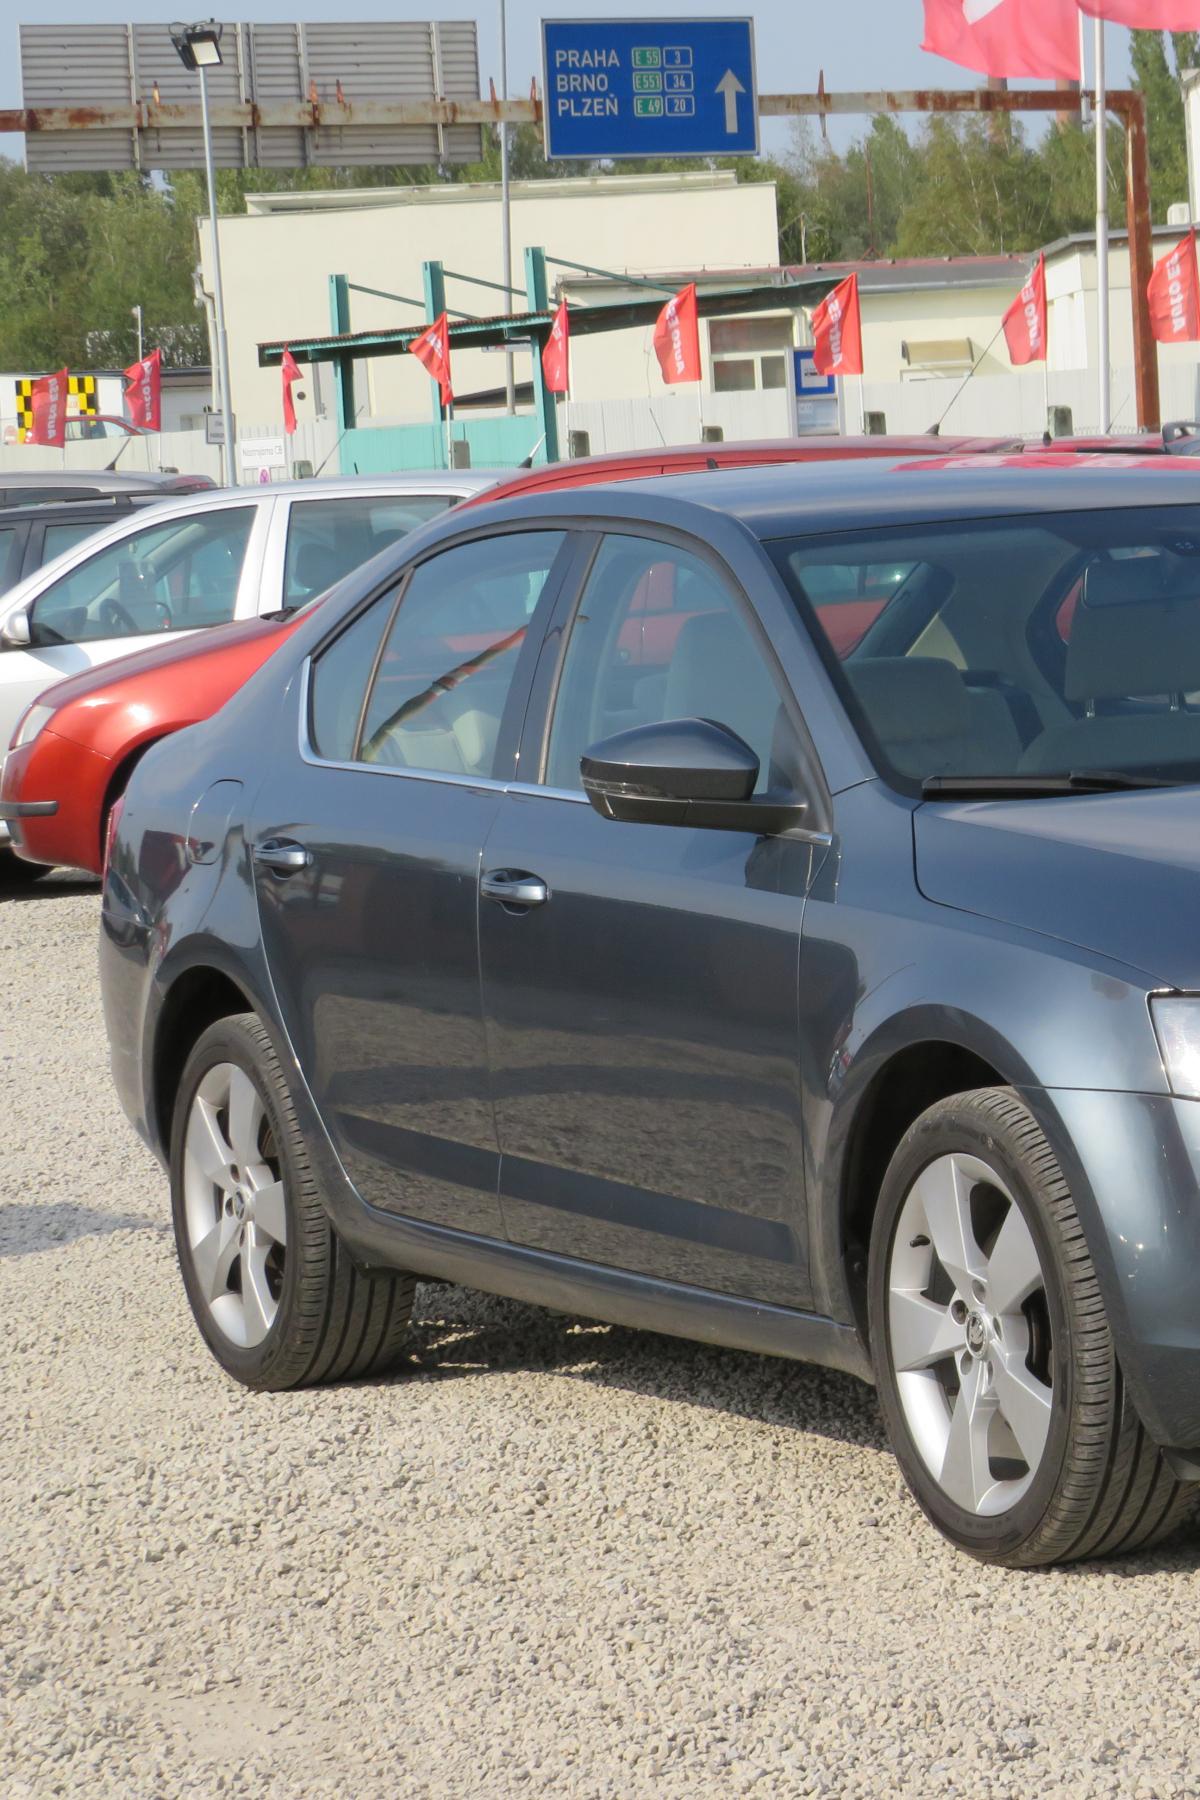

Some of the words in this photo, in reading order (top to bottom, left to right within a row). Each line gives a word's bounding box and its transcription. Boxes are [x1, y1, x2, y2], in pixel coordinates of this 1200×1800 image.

[556, 49, 620, 68] PRAHA
[646, 49, 660, 66] 55
[674, 50, 681, 65] 3
[556, 74, 608, 92] BRNO
[672, 74, 686, 88] 34
[558, 93, 619, 117] PLZEŇ
[648, 98, 660, 114] 49
[674, 98, 686, 113] 20
